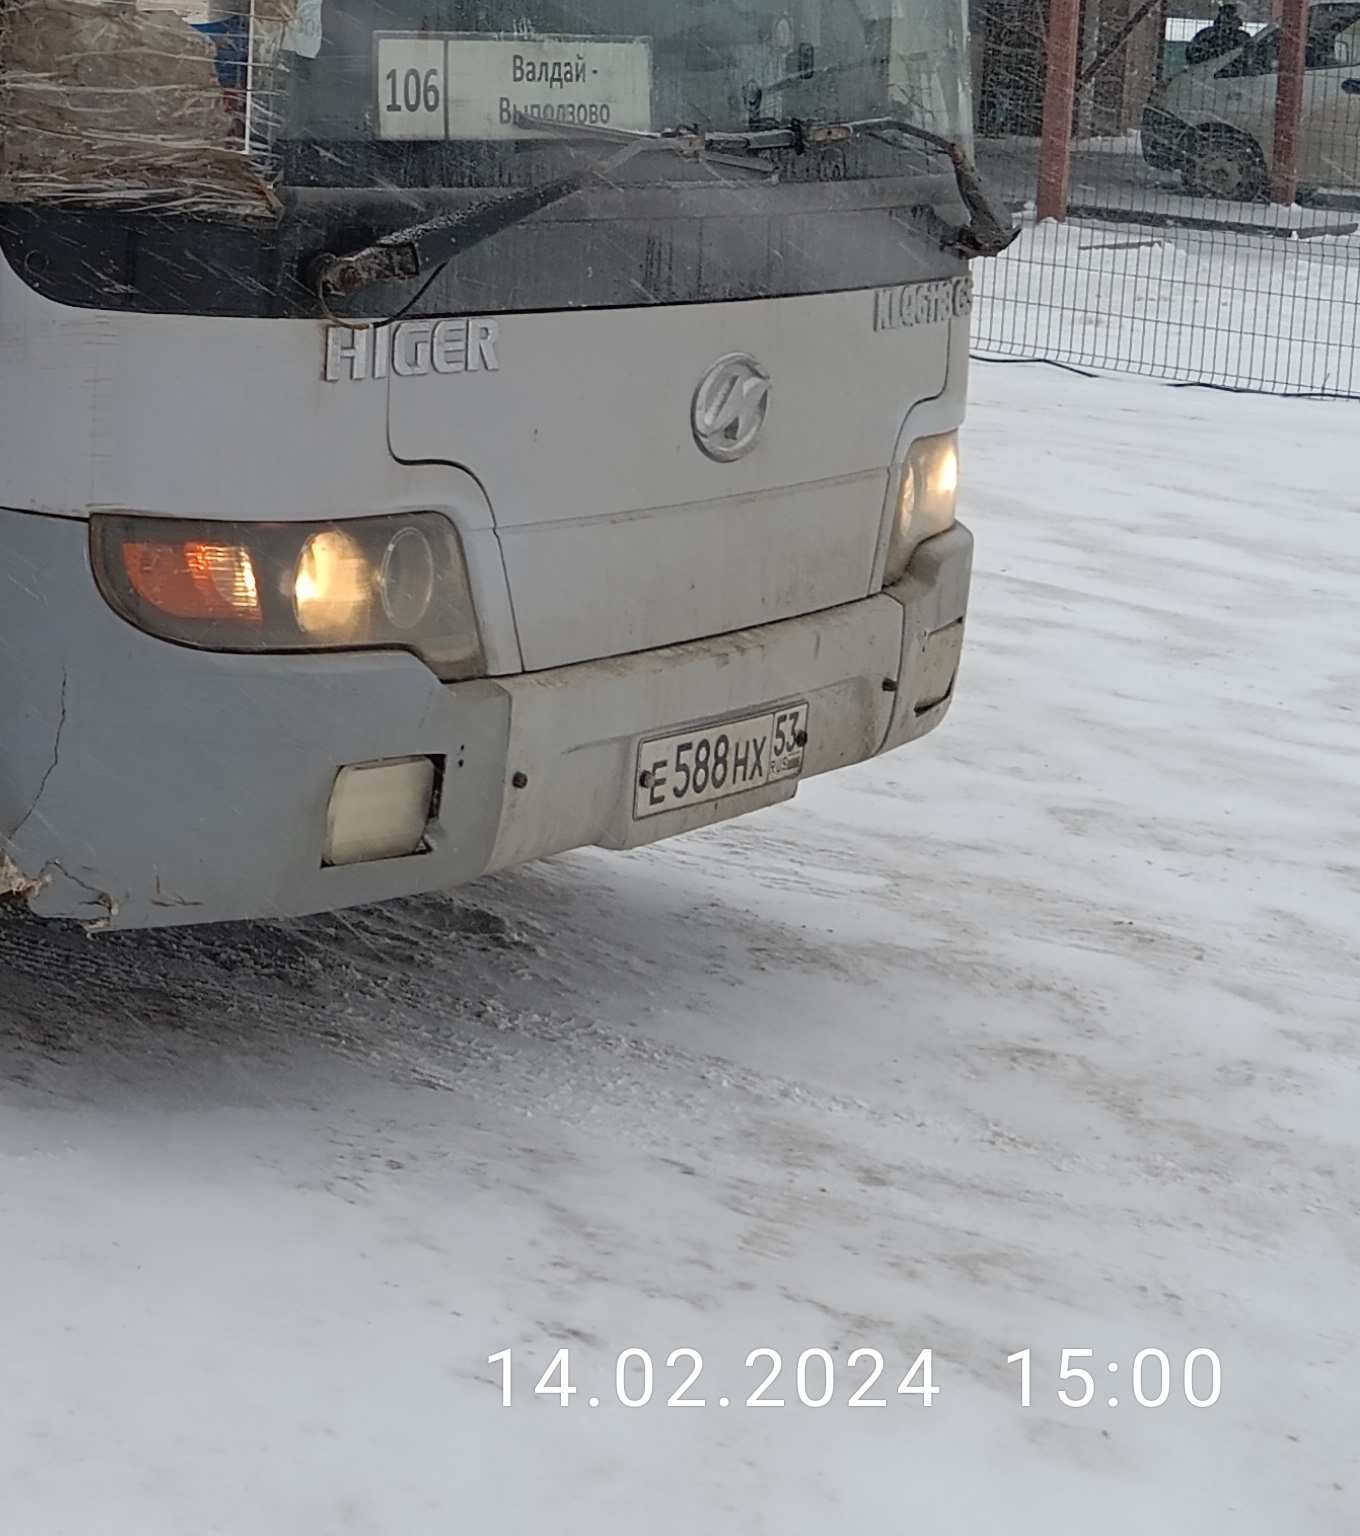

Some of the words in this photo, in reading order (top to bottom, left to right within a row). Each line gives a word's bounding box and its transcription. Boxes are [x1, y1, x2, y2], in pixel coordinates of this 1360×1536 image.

[385, 68, 440, 113] 106
[512, 54, 586, 89] Валдай
[325, 318, 500, 382] HIGER
[773, 711, 802, 757] 53
